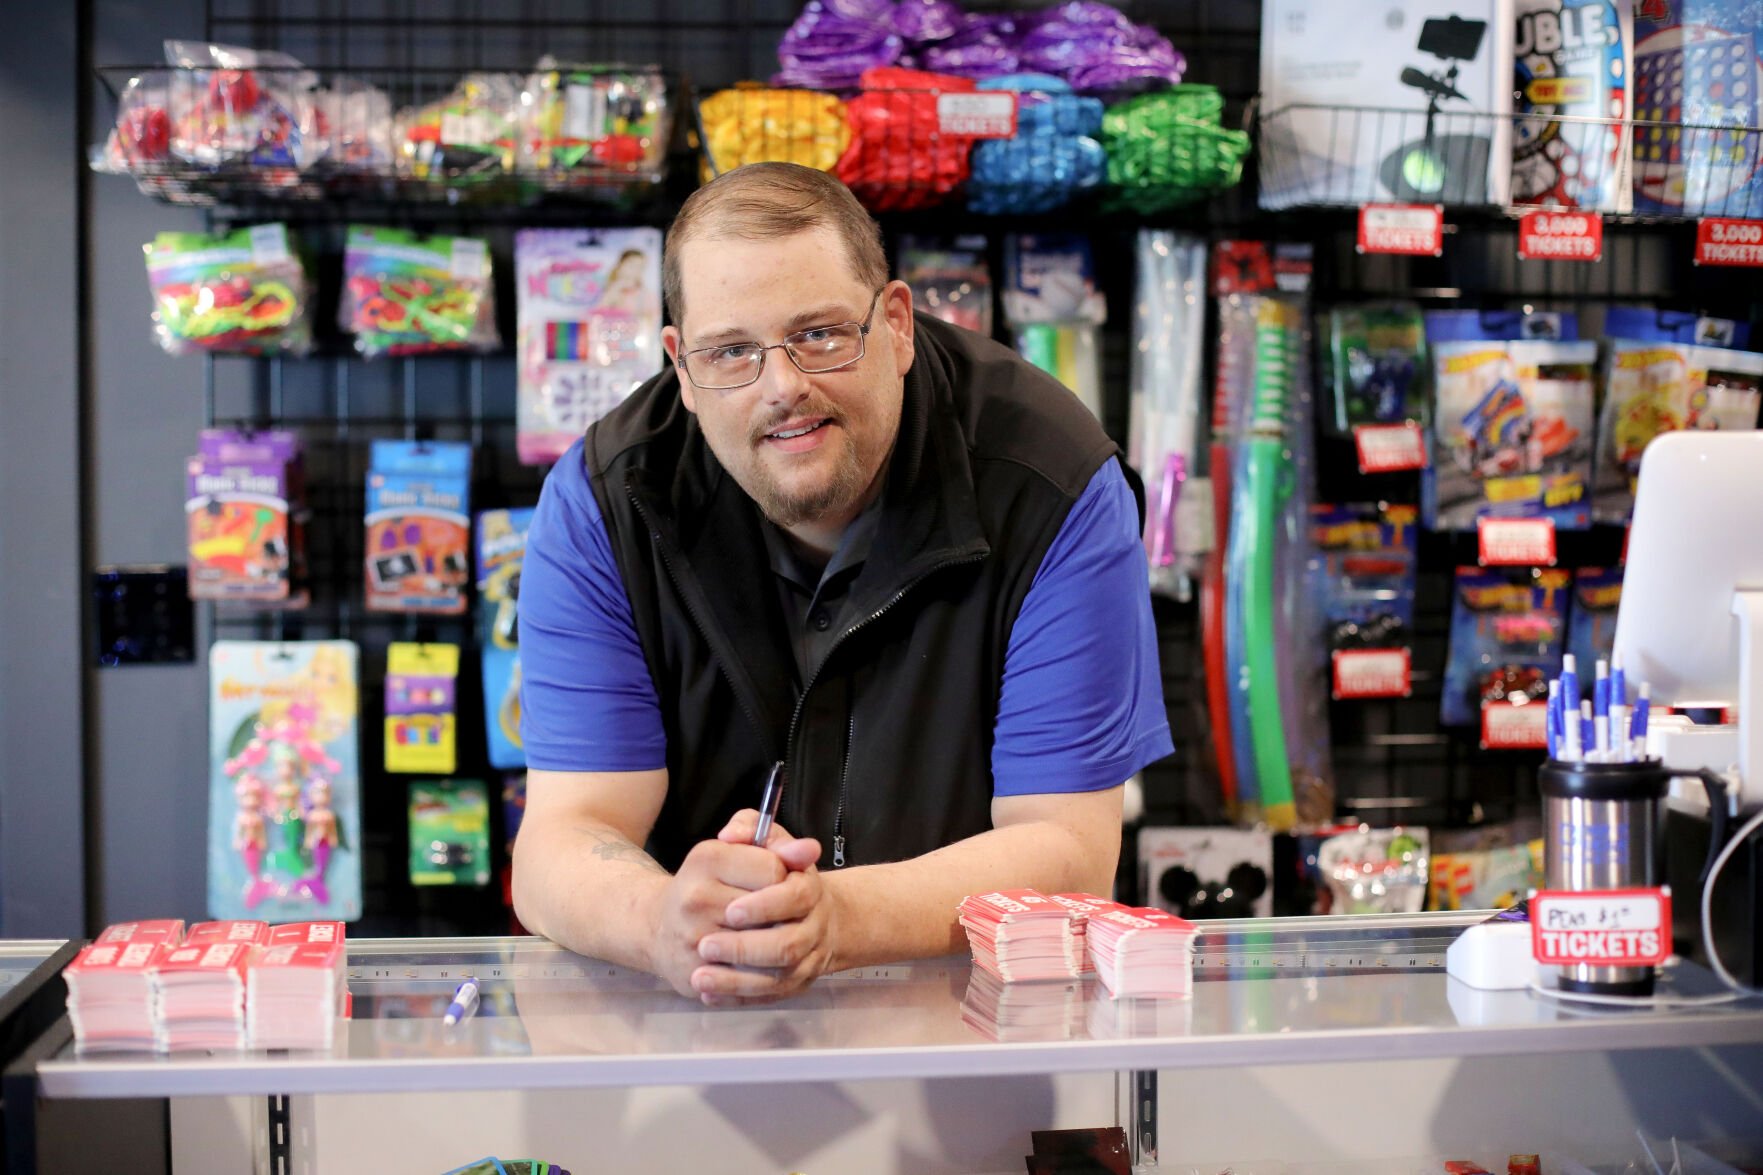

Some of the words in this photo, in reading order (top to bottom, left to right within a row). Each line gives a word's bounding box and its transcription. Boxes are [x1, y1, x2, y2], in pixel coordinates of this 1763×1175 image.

[939, 117, 1012, 134] TICKETS
[1535, 215, 1588, 236] 3,000
[1711, 223, 1762, 242] 3,000
[1366, 228, 1435, 251] TICKETS
[1526, 234, 1595, 256] TICKETS
[979, 892, 1031, 912] TICKETS
[1049, 895, 1101, 911] TICKETS
[1099, 911, 1158, 928] TICKETS
[1541, 931, 1660, 958] TICKETS
